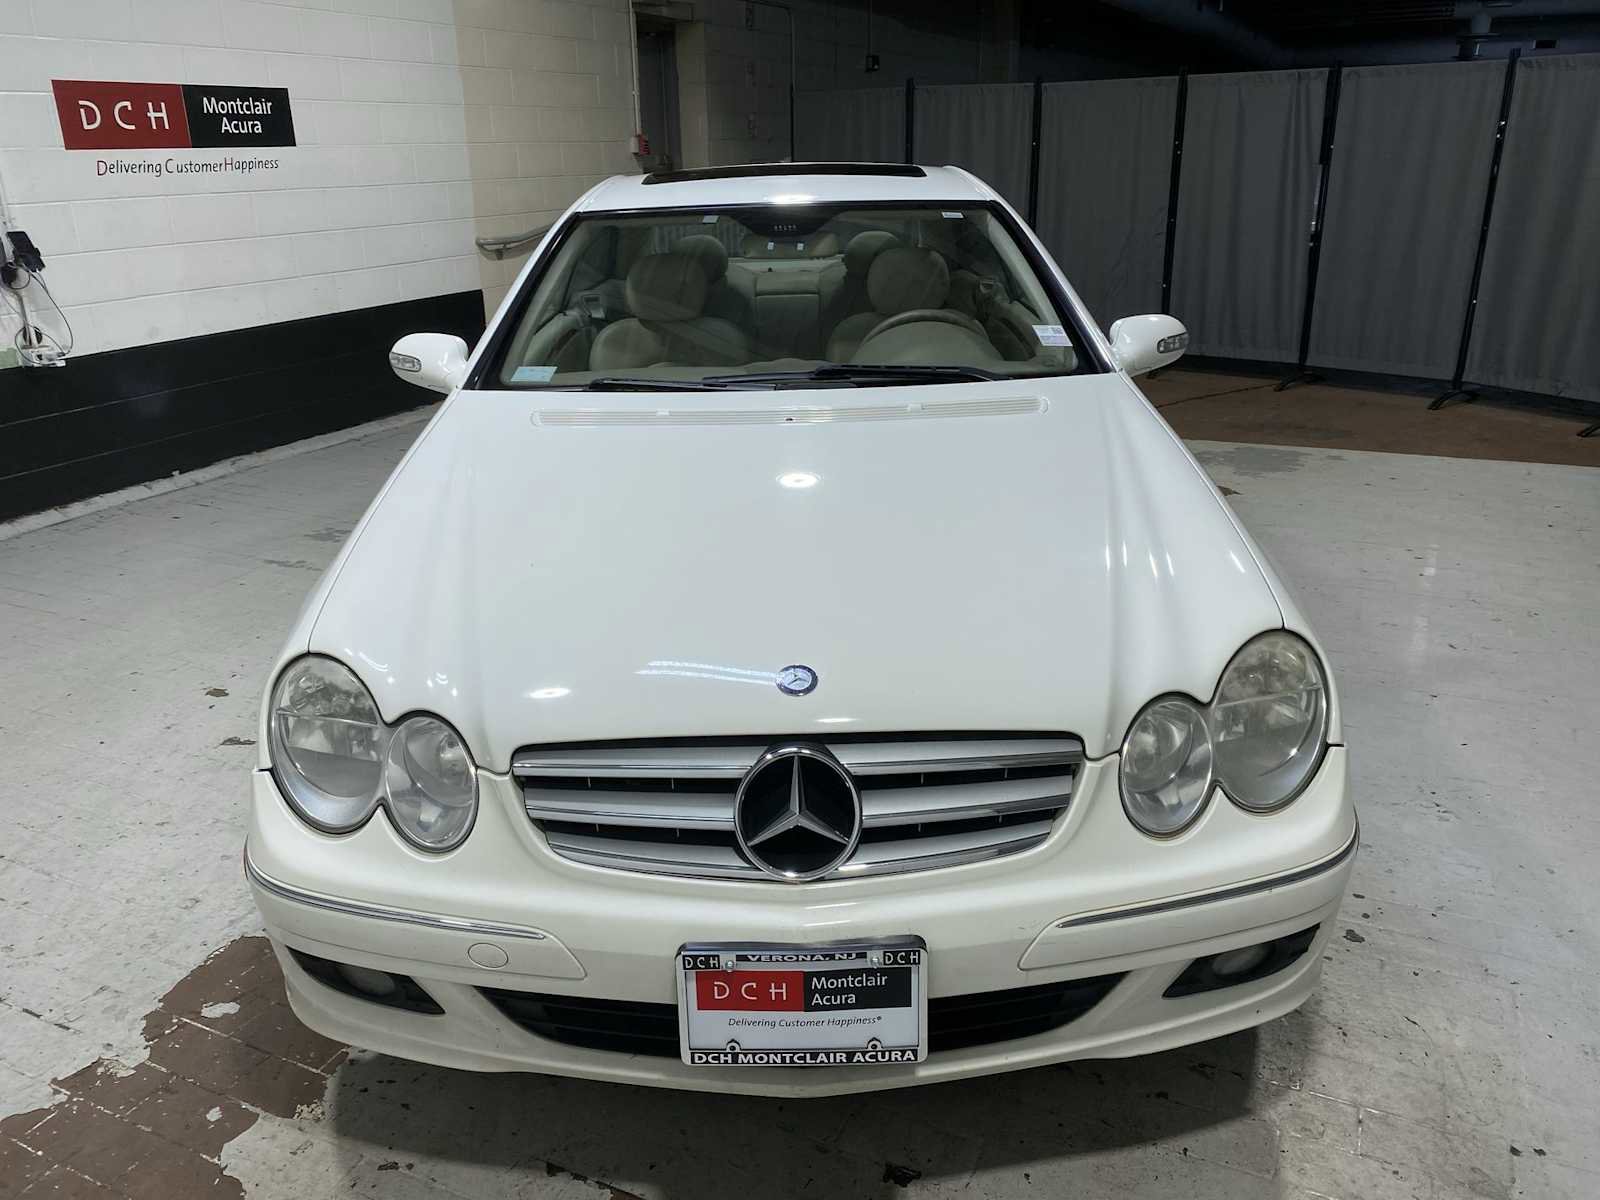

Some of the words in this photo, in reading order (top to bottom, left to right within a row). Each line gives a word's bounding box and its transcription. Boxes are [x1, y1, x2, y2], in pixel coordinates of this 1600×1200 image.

[202, 97, 273, 114] Montclair
[79, 100, 170, 130] DCH
[221, 116, 263, 134] Acura
[97, 160, 162, 178] Delivering
[165, 158, 223, 174] Customer
[224, 157, 279, 173] Happiness
[684, 957, 719, 969] DCH
[834, 952, 857, 960] NJ
[885, 951, 919, 964] DCH
[811, 973, 888, 990] Montclair
[713, 981, 787, 1001] DCH
[811, 993, 856, 1006] Acura
[728, 1018, 776, 1029] Delivering
[778, 1018, 824, 1027] Customer
[694, 1053, 732, 1064] DCH
[737, 1052, 847, 1064] MONTCLAIR
[852, 1050, 915, 1063] ACURA
